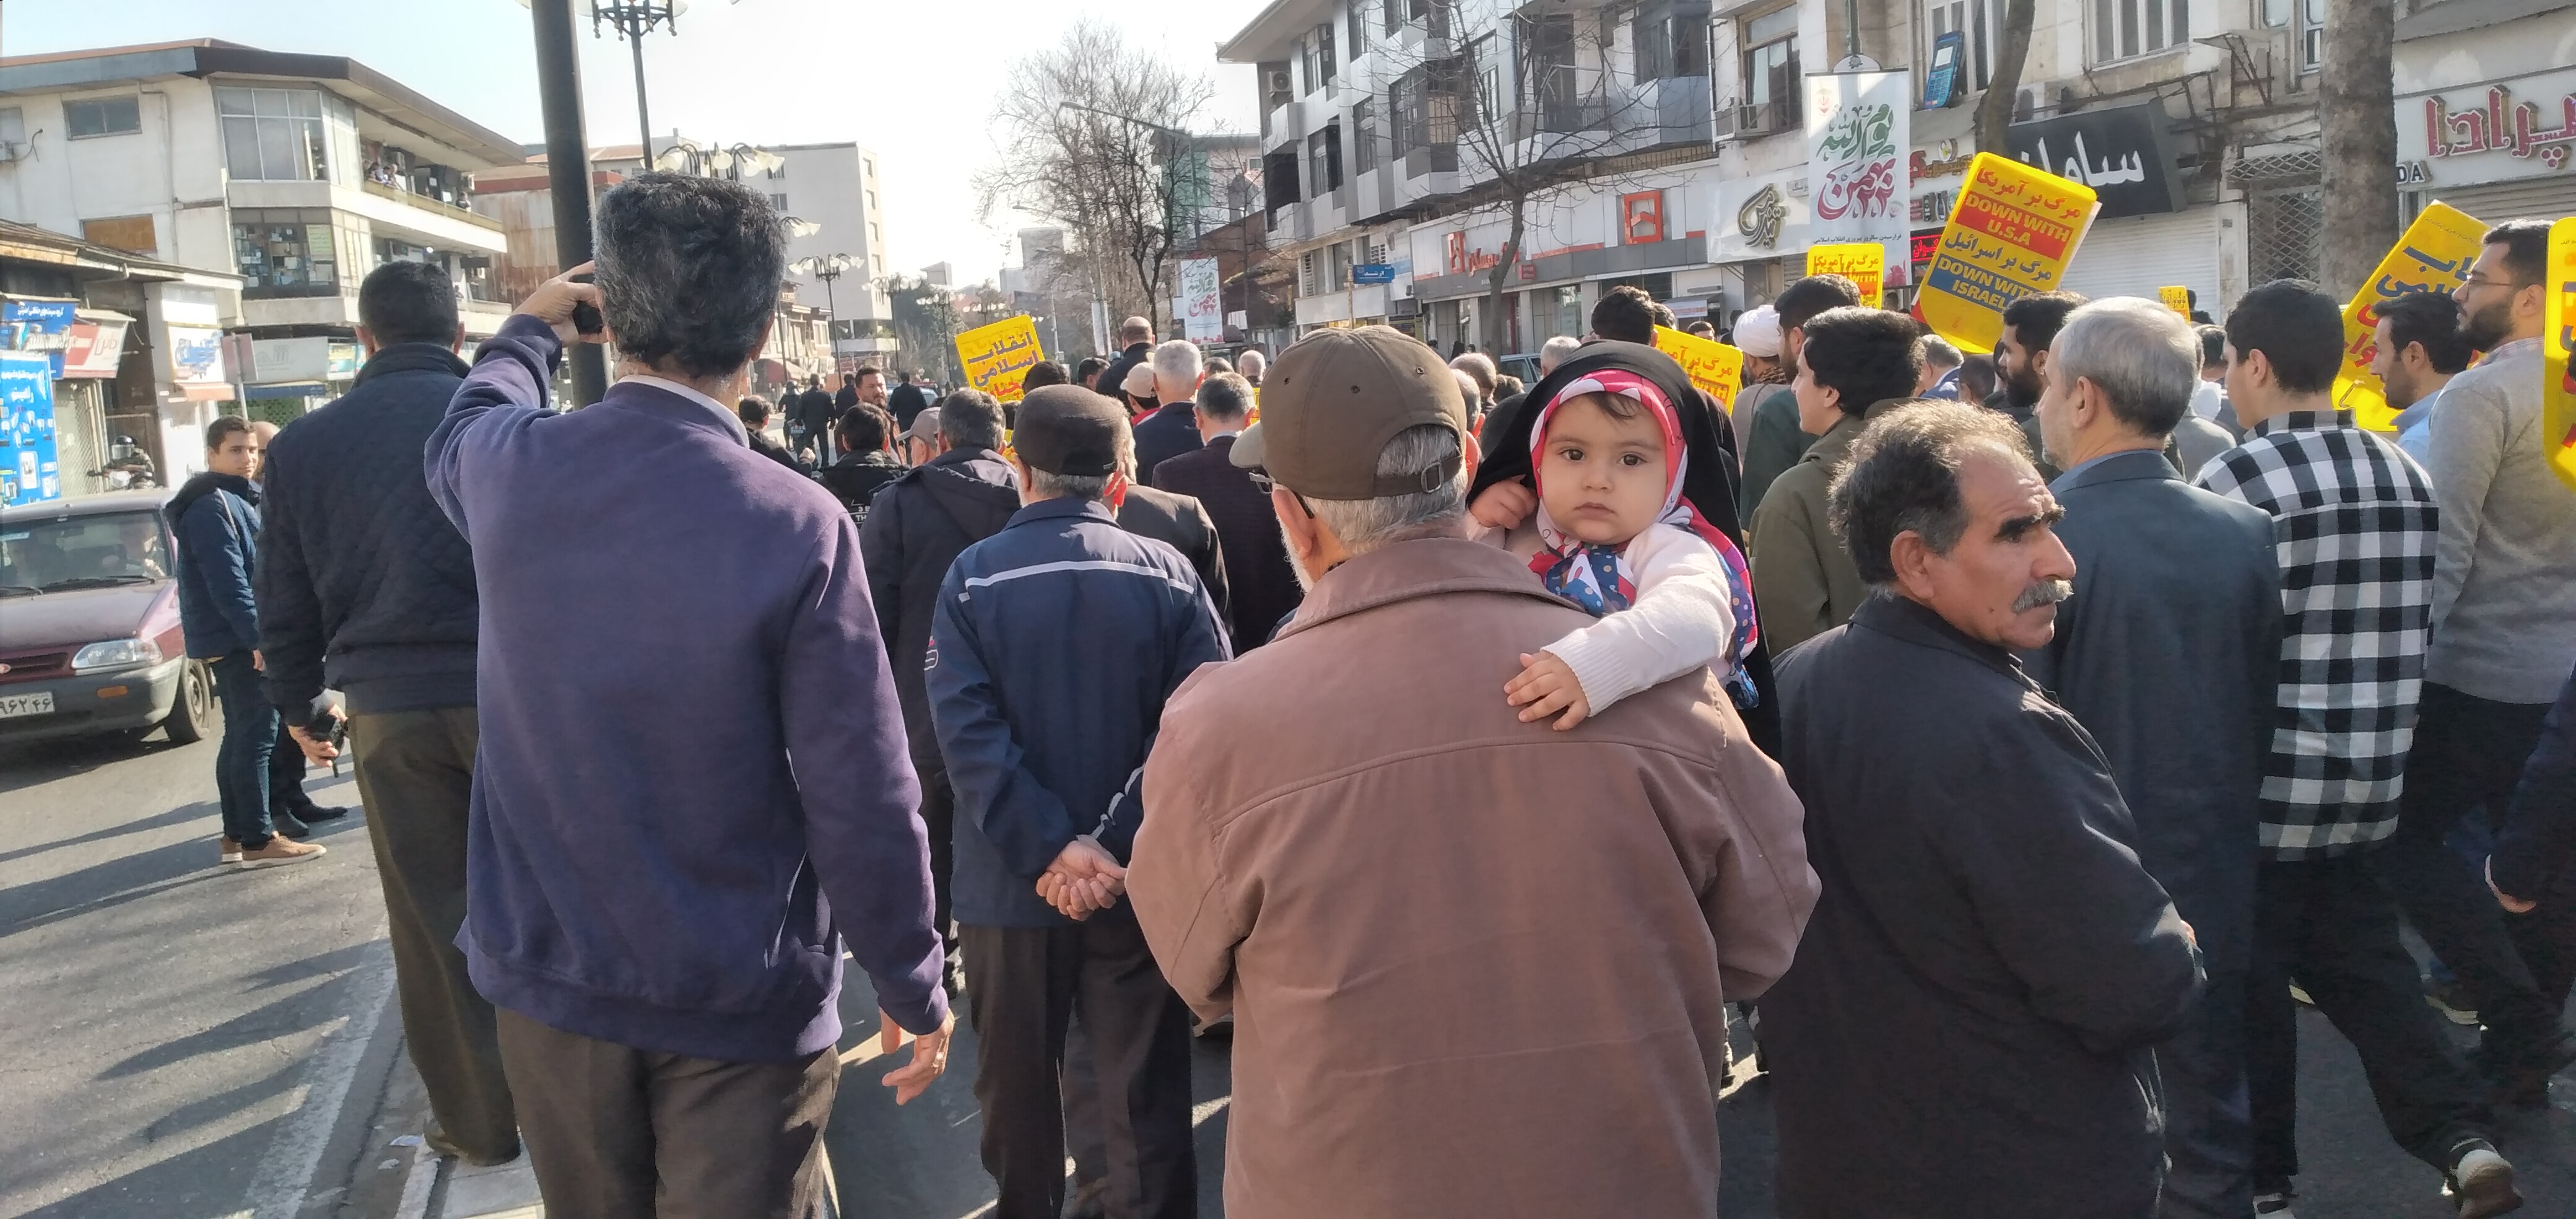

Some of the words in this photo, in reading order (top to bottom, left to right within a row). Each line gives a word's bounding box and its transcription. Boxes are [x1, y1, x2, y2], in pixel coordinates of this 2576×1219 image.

[2021, 131, 2145, 186] ساما
[1976, 167, 2029, 196] آمریکا
[2024, 194, 2043, 208] بر
[2043, 196, 2080, 219] مرگ
[1965, 194, 2023, 224] DOWN
[2024, 214, 2070, 242] WITH
[1813, 237, 1830, 245] اسلامی
[1944, 231, 2004, 260] اسرائیل
[1987, 219, 2031, 246] U.S.A
[1856, 254, 1879, 268] مرگ
[1938, 256, 1994, 287] DOWN
[1998, 256, 2017, 271] بر
[2020, 261, 2052, 282] مرگ
[1952, 279, 2007, 310] ISRAEL
[968, 331, 1033, 365] انقلاب
[974, 350, 1039, 387] اسلامی
[1703, 357, 1733, 378] مرگ
